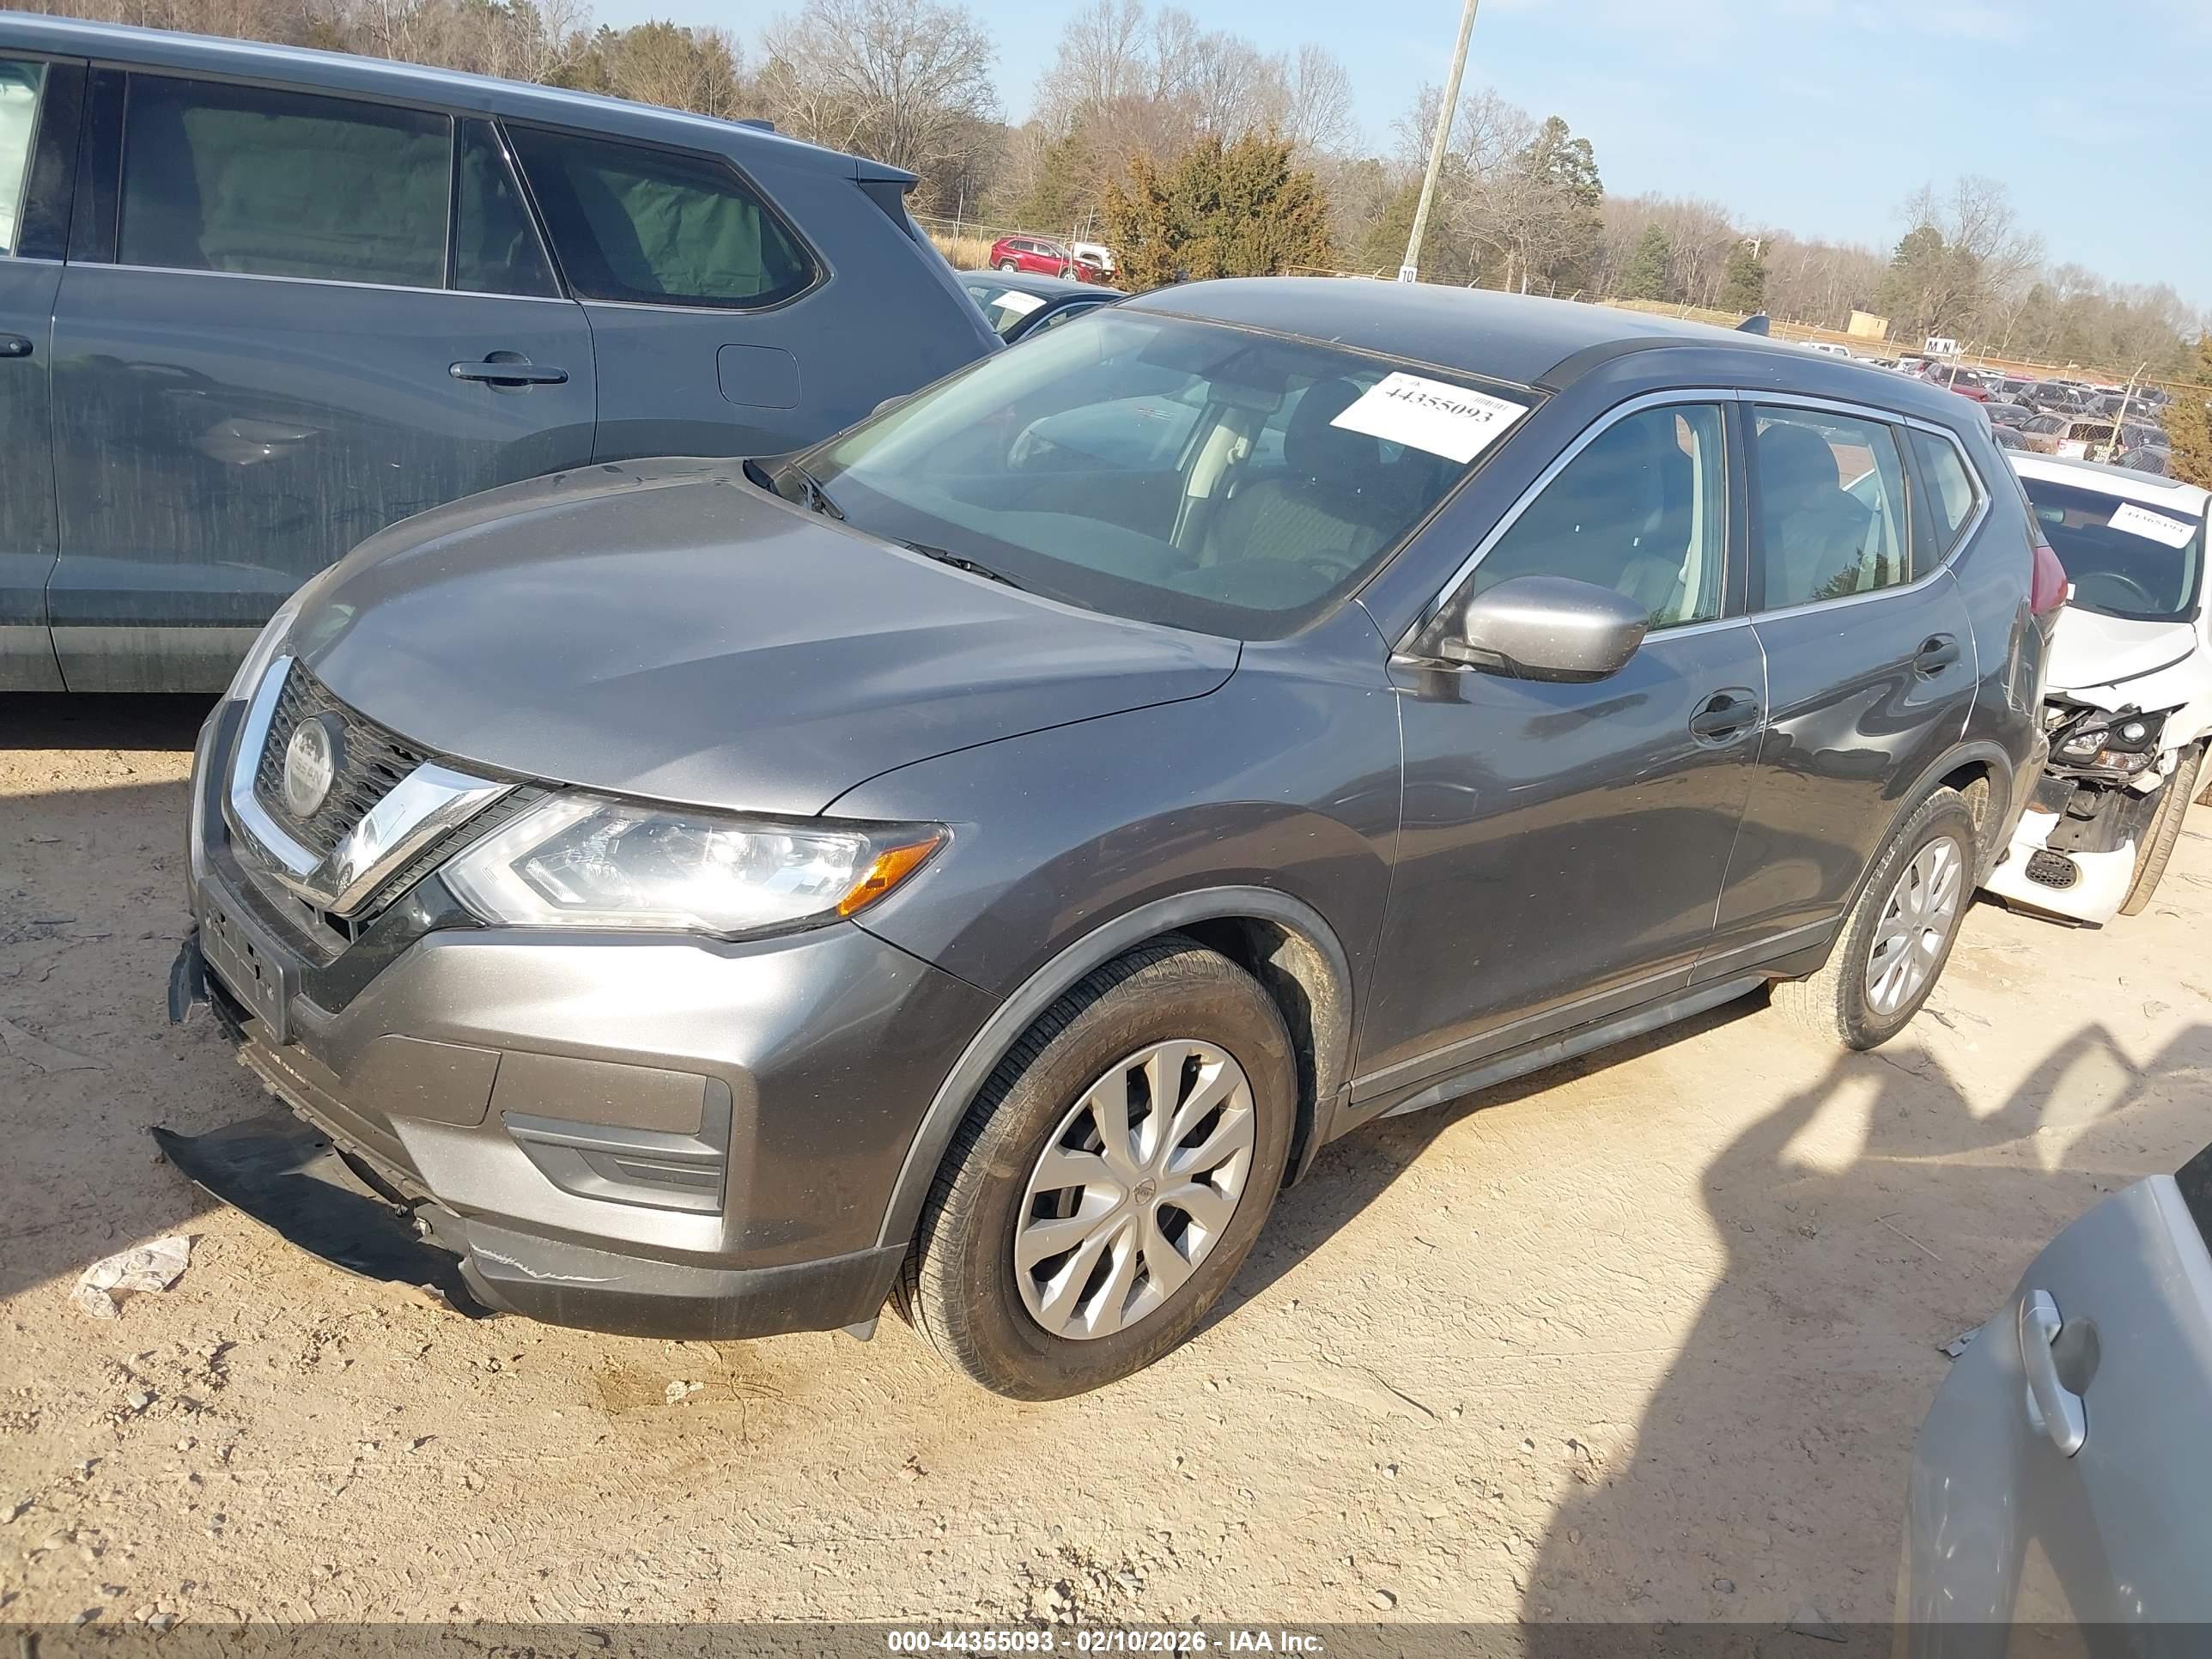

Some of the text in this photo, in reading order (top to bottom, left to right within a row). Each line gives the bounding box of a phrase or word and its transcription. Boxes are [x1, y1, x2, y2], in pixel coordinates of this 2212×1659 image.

[1402, 270, 1414, 283] 10
[1927, 341, 1952, 353] M N
[1385, 388, 1494, 422] 44355093
